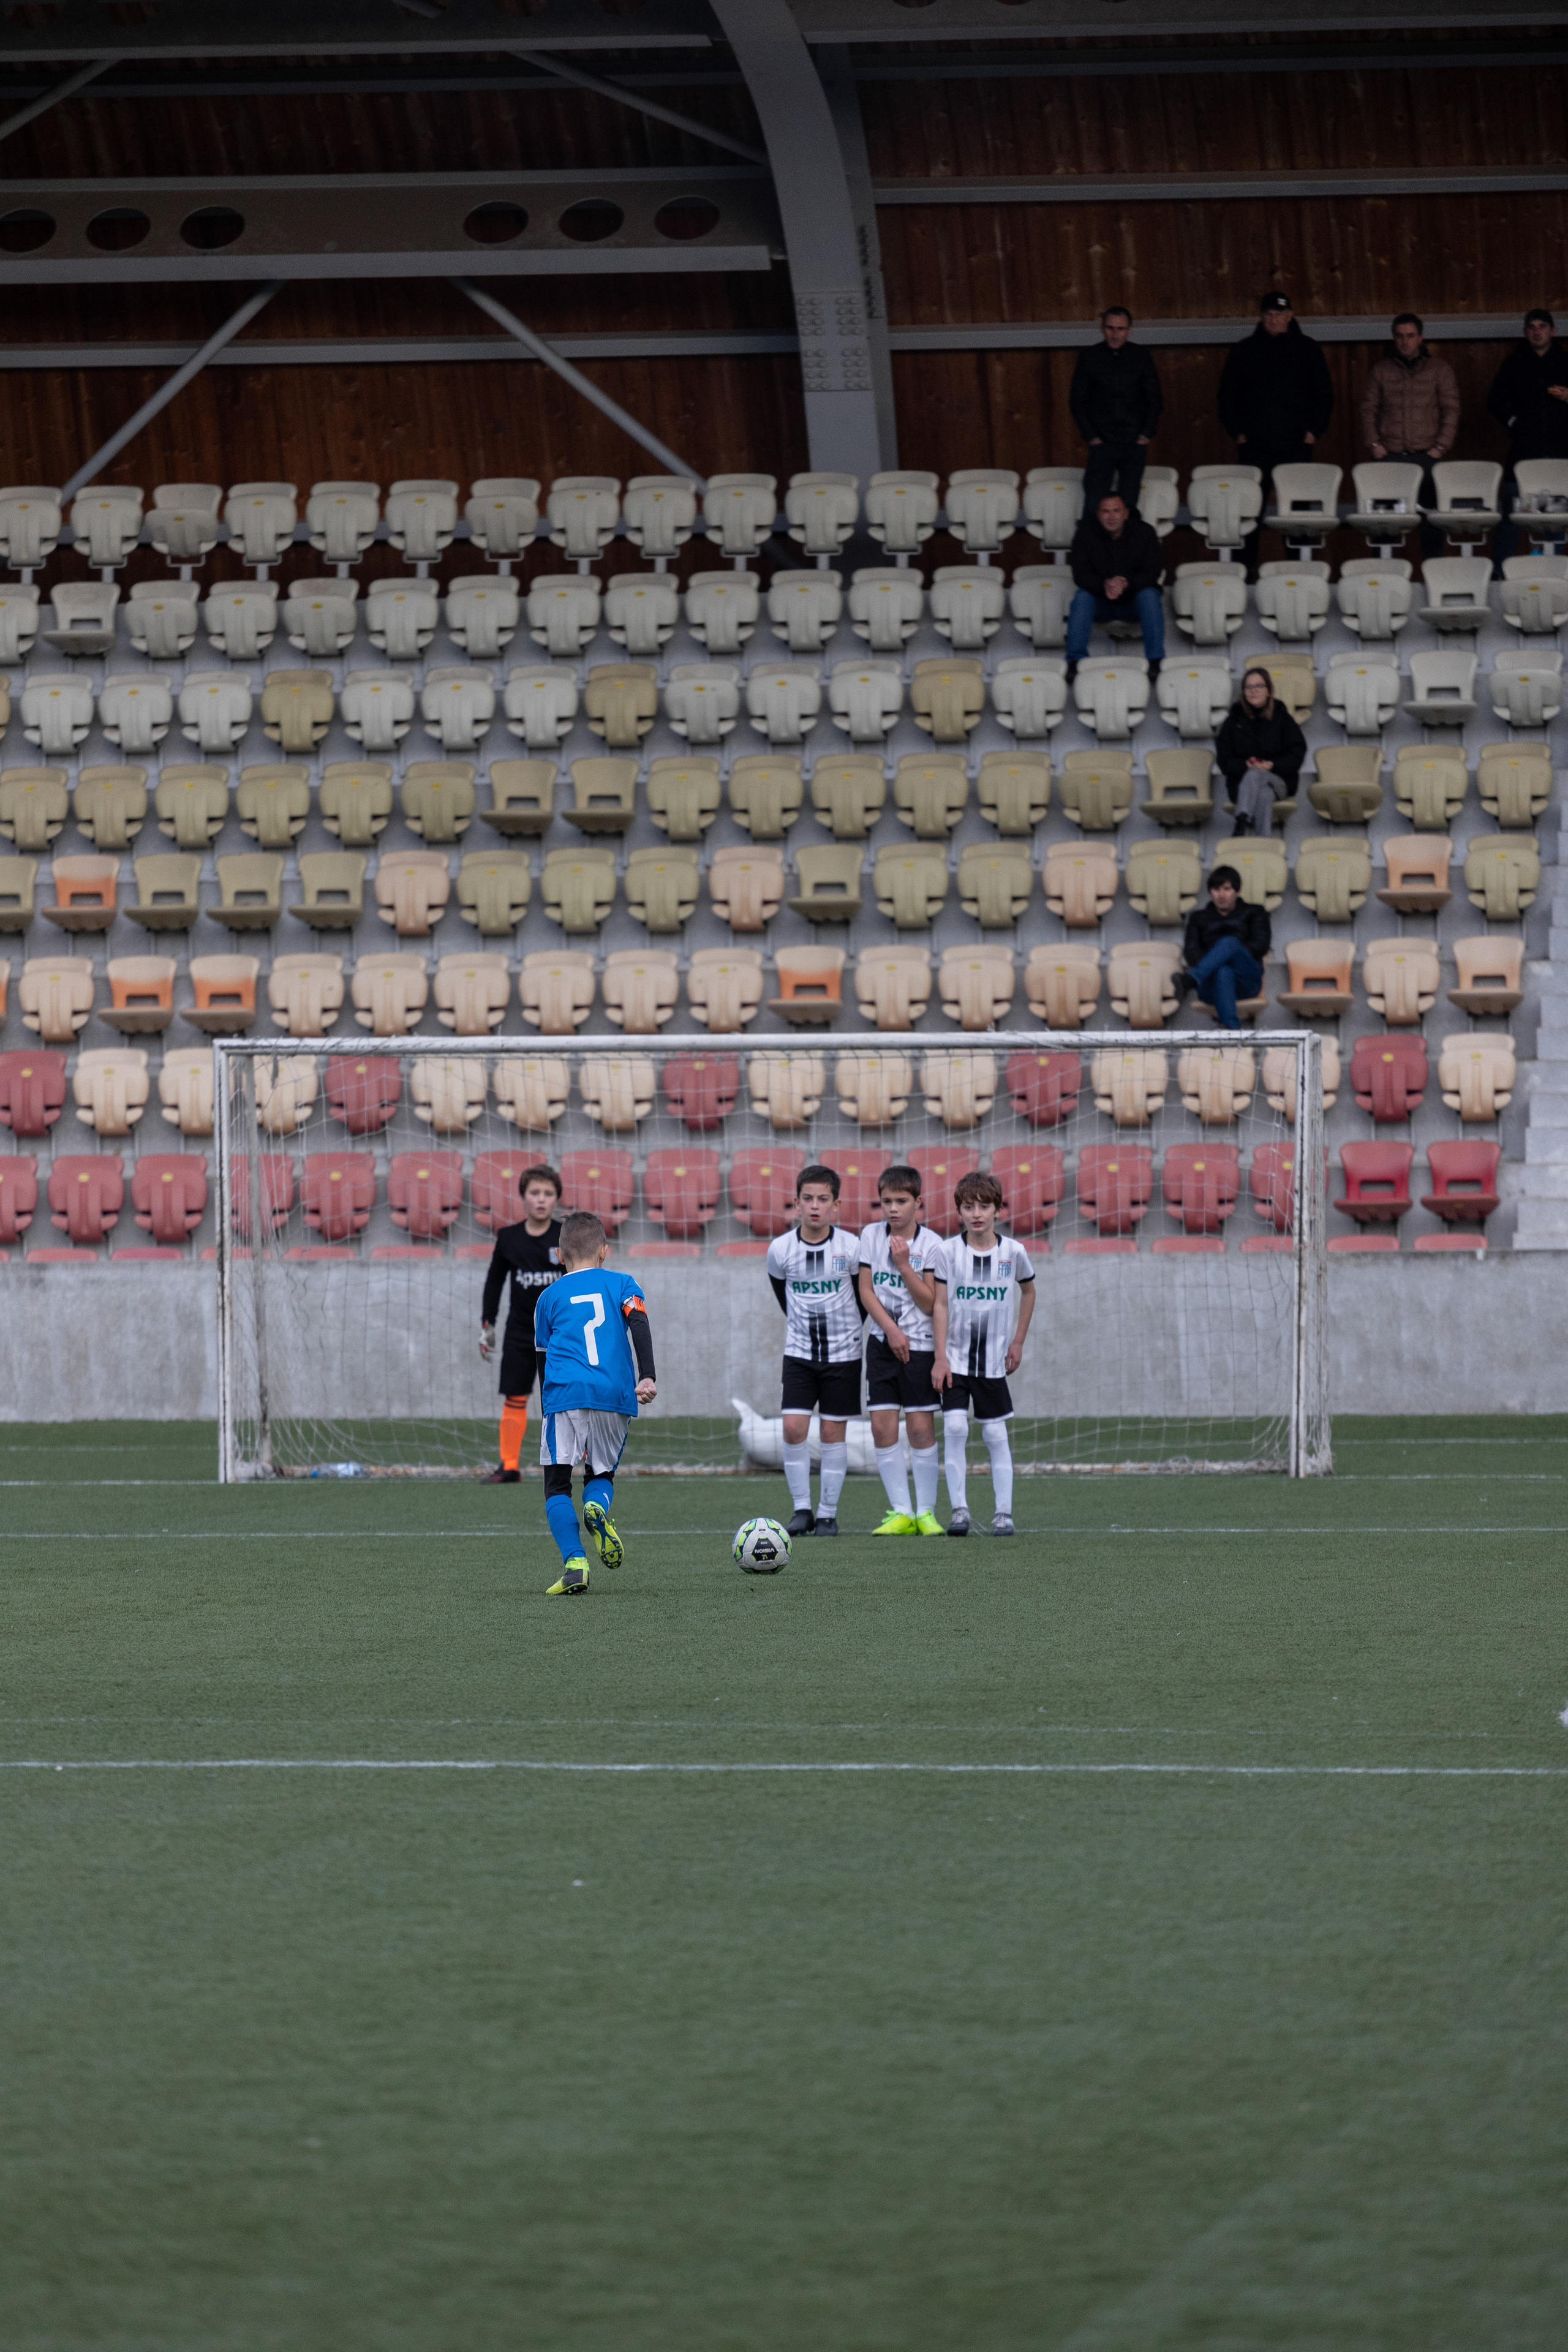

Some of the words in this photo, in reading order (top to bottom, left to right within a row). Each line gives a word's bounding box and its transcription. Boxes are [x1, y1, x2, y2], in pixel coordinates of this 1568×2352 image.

[792, 1279, 842, 1294] APSNY
[873, 1271, 907, 1288] APSN
[957, 1286, 1008, 1302] APSNY
[570, 1293, 605, 1365] 7
